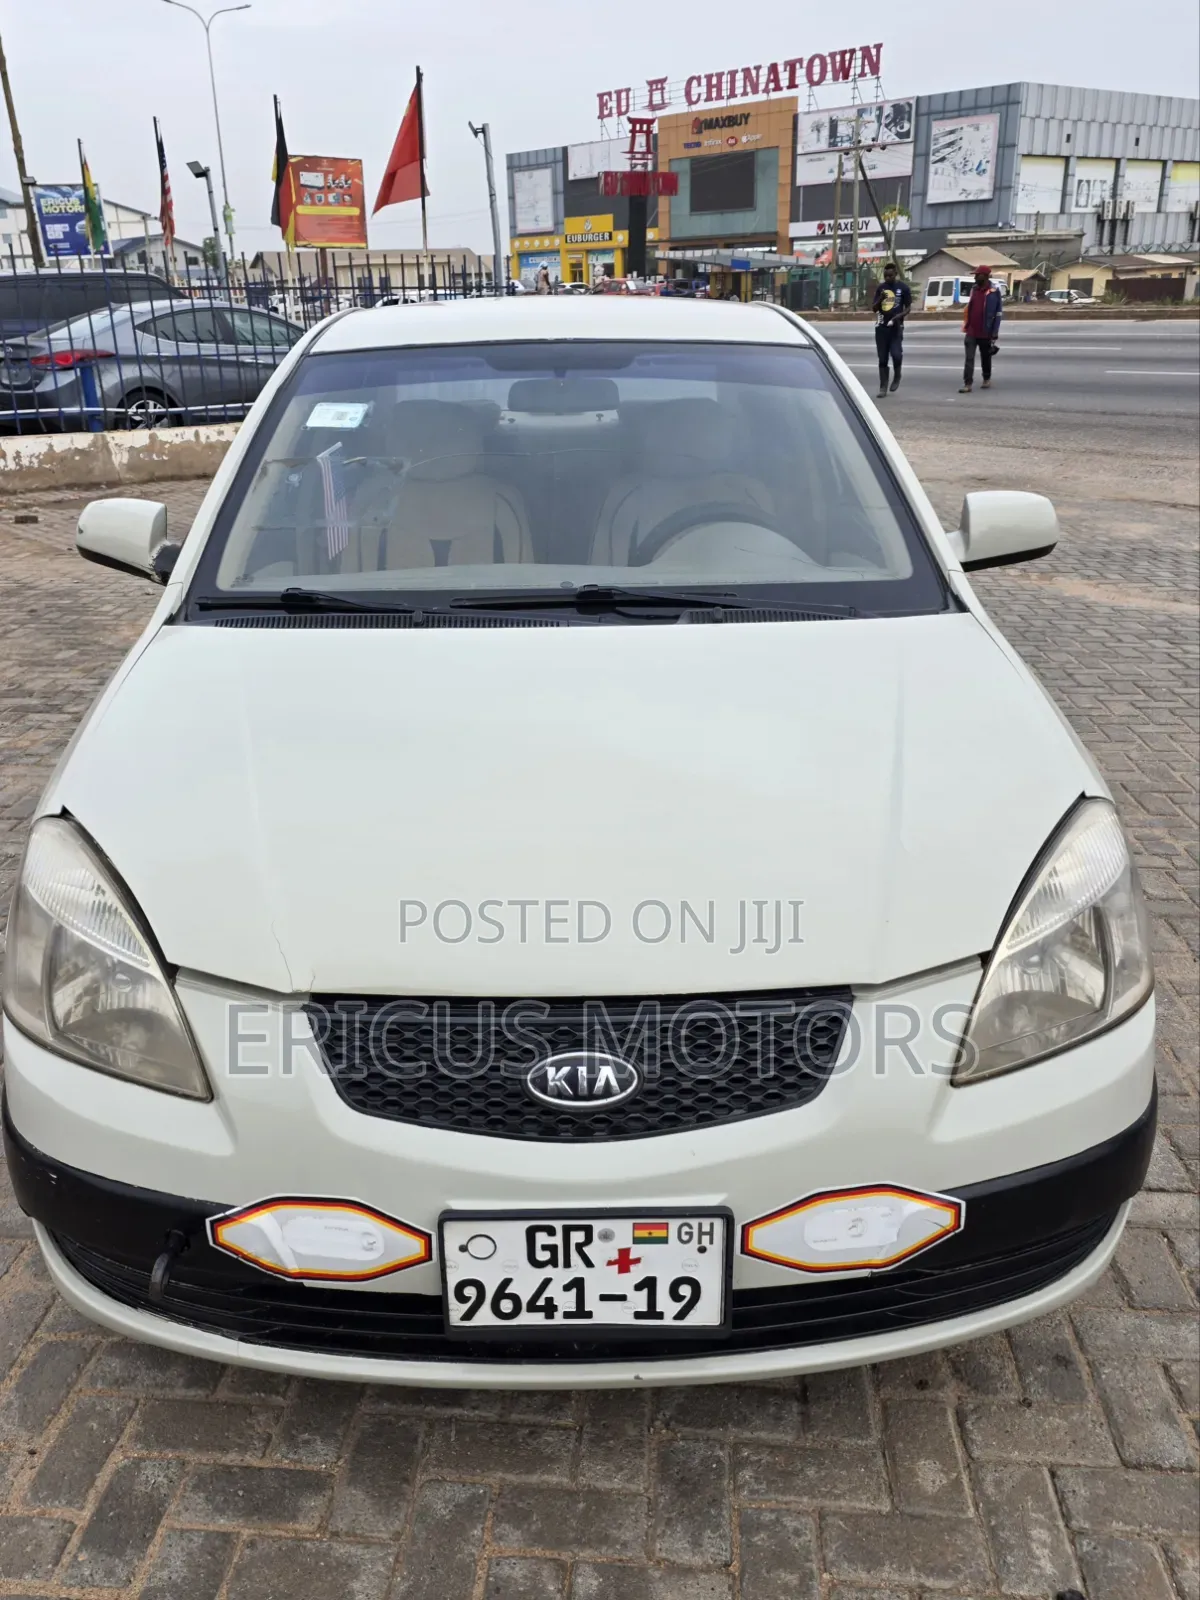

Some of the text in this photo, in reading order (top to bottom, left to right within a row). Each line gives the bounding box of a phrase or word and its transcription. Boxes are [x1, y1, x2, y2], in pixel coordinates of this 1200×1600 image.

[596, 43, 883, 119] EU CHINATOWN
[704, 113, 750, 130] MAXBUY
[42, 205, 84, 214] MOTOR
[566, 232, 610, 244] EUBURGER
[546, 1066, 620, 1096] KIA
[525, 1222, 714, 1269] GR GH
[453, 1276, 702, 1321] 9641-19
